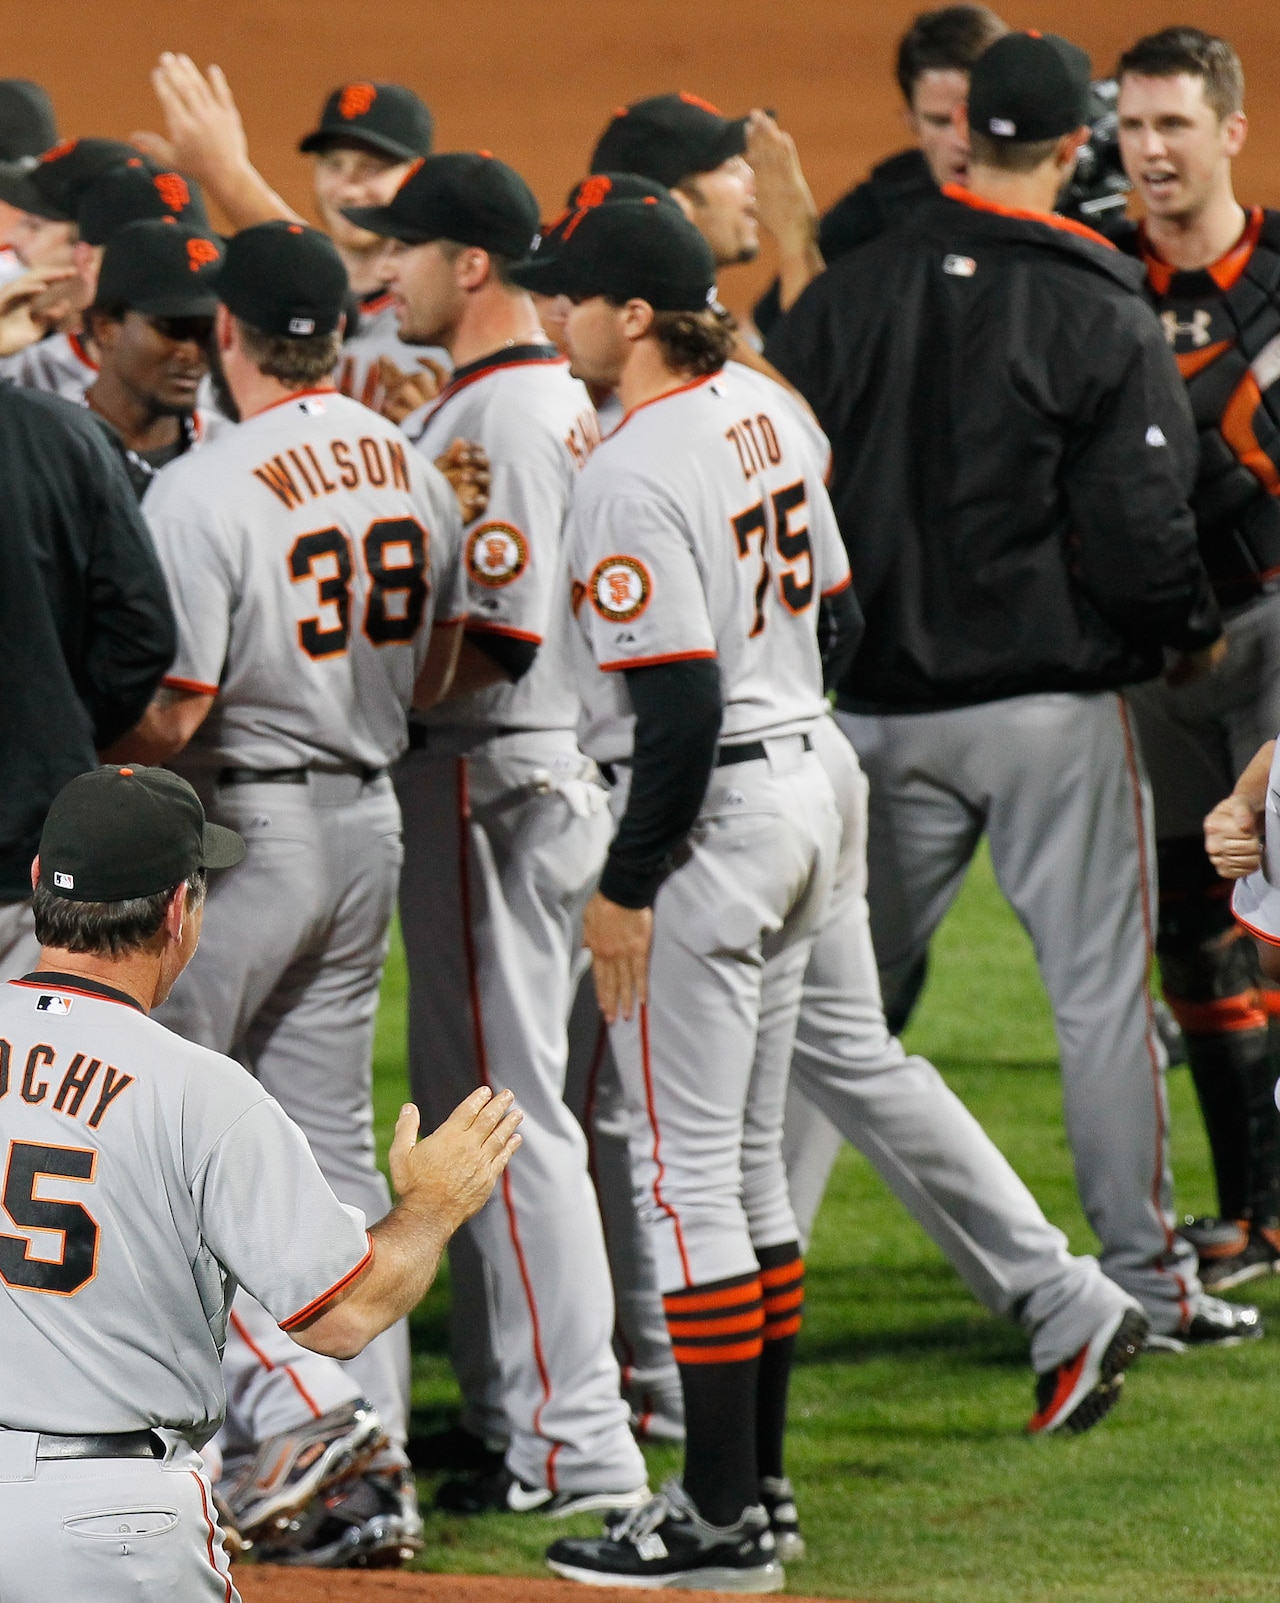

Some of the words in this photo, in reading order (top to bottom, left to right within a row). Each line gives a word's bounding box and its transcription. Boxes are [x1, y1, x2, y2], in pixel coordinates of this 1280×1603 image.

[253, 434, 411, 511] WILSON
[724, 412, 781, 481] ZITO
[286, 513, 432, 662] 38
[729, 475, 814, 639] 75
